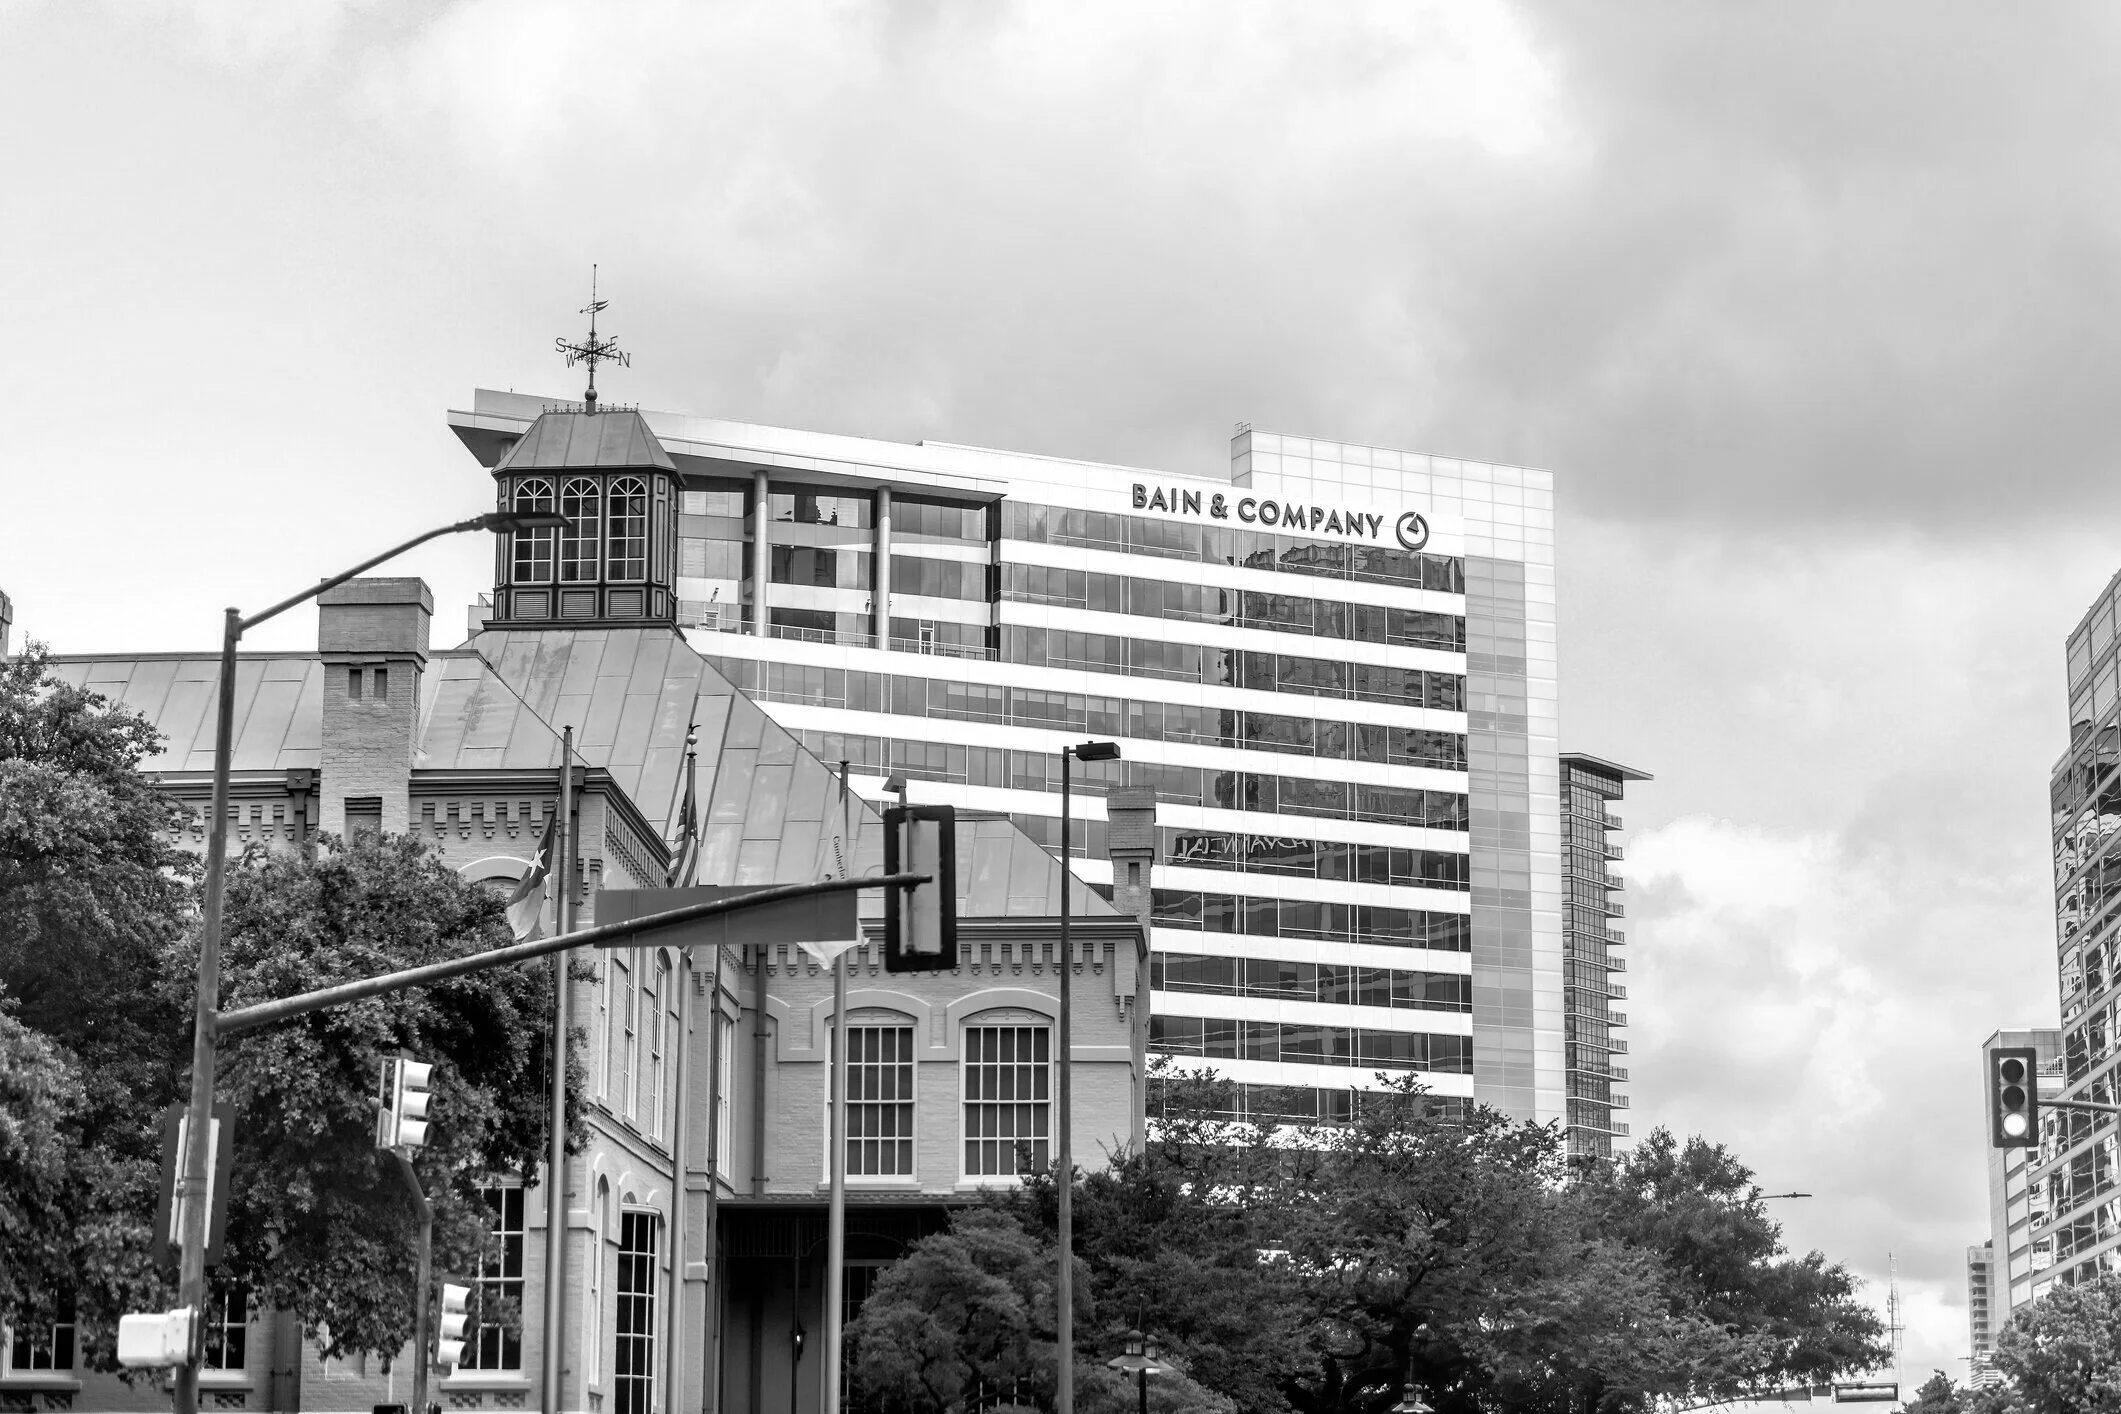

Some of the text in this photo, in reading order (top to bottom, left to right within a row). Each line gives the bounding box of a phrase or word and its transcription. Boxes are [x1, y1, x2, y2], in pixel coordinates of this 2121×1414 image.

[555, 337, 567, 353] S
[609, 335, 619, 352] E
[565, 351, 577, 369] W
[617, 350, 631, 368] N
[1132, 483, 1383, 539] BAIN & COMPANY
